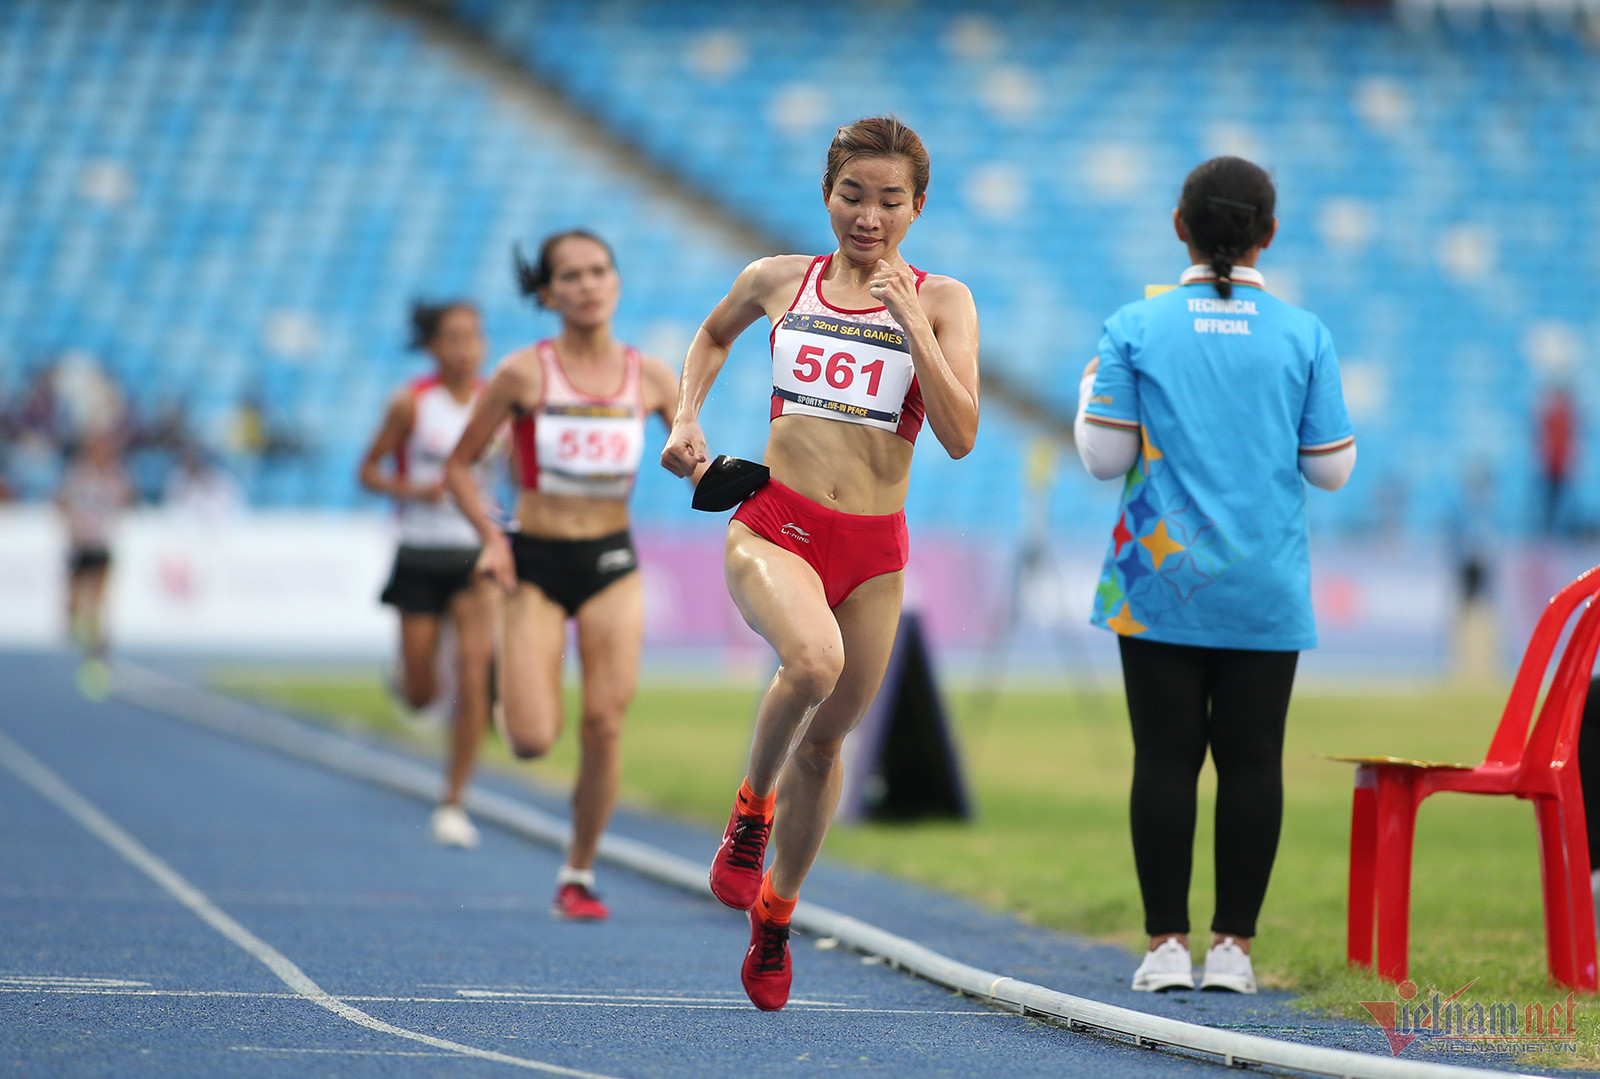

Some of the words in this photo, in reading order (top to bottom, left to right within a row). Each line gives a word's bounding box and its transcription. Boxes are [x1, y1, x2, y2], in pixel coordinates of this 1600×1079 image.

[1187, 298, 1259, 315] TECHNICAL
[812, 319, 838, 332] 32nd
[840, 326, 861, 337] SEA
[863, 329, 903, 345] GAMES
[1194, 318, 1252, 335] OFFICIAL
[792, 344, 885, 397] 561
[797, 395, 823, 407] SPORTS
[847, 405, 868, 417] PEACE
[557, 428, 629, 462] 559
